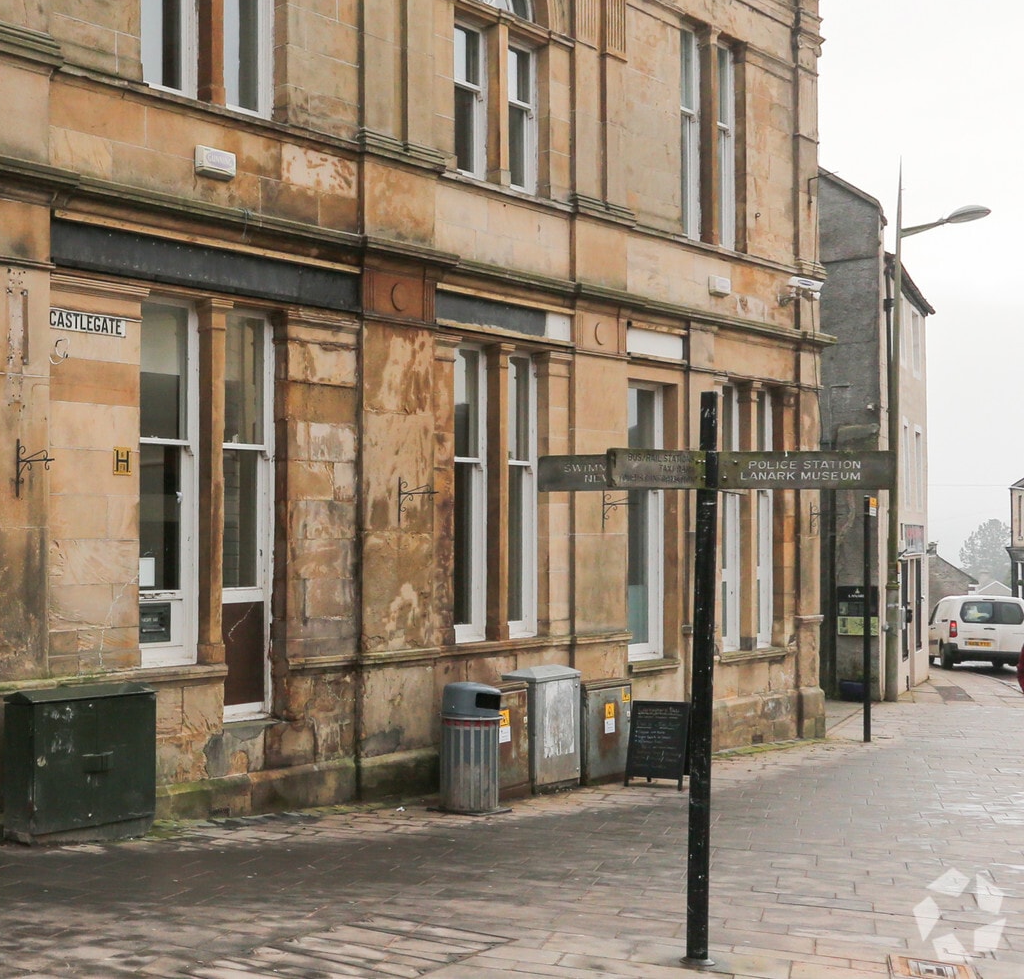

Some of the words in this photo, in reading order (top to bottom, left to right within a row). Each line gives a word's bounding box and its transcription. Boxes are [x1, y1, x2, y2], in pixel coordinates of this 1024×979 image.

[49, 310, 122, 335] CASTLEGATE
[748, 460, 797, 469] POLICE
[803, 460, 861, 469] STATION
[740, 472, 795, 480] LANARK
[801, 472, 861, 480] MUSEUM
